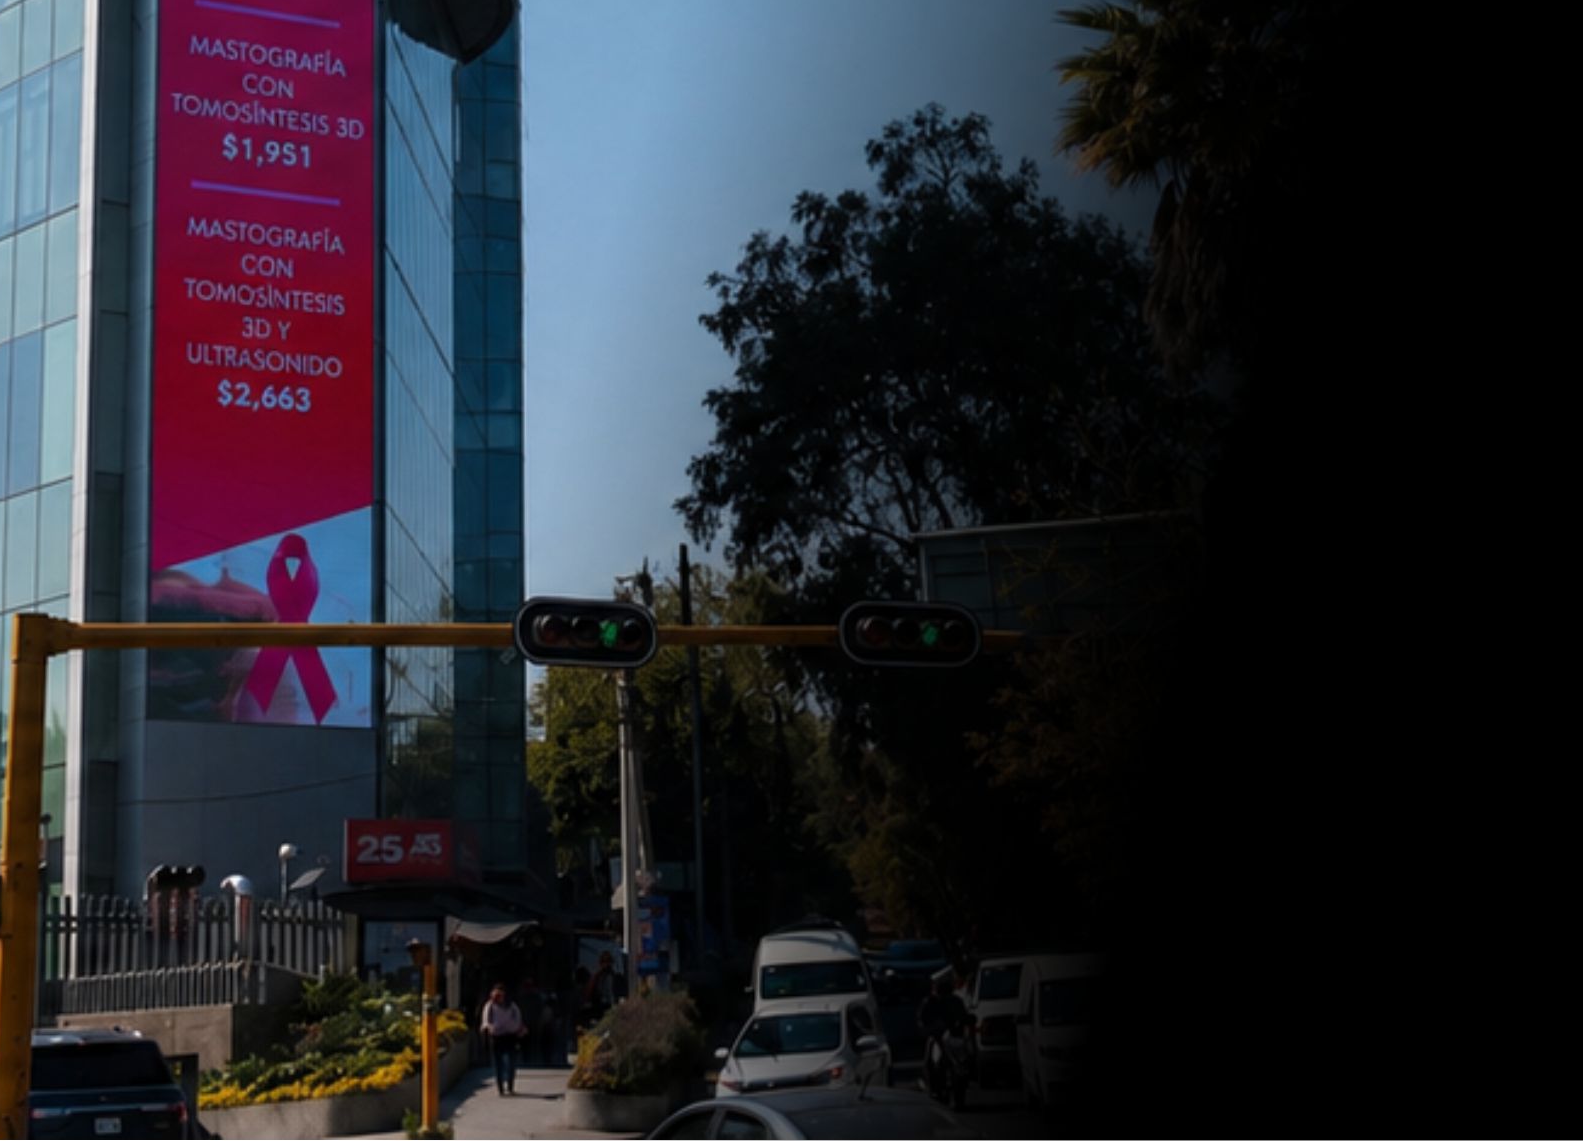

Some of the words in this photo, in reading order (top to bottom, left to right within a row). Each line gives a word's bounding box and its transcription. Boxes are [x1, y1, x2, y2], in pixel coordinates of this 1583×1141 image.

[189, 34, 346, 77] MASTOGRAFÍA
[241, 73, 295, 99] CON
[171, 92, 329, 136] TOMOSÍNTESIS
[336, 117, 365, 141] 3D
[222, 132, 312, 168] $1,951
[186, 216, 346, 256] MASTOGRAFÍA
[240, 254, 294, 279] CON
[183, 277, 346, 315] TOMOSÍNTESIS
[241, 316, 271, 340] 3D
[276, 320, 291, 340] Y
[185, 342, 343, 378] ULTRASONIDO
[217, 379, 311, 412] $2,663
[355, 833, 405, 865] 25
